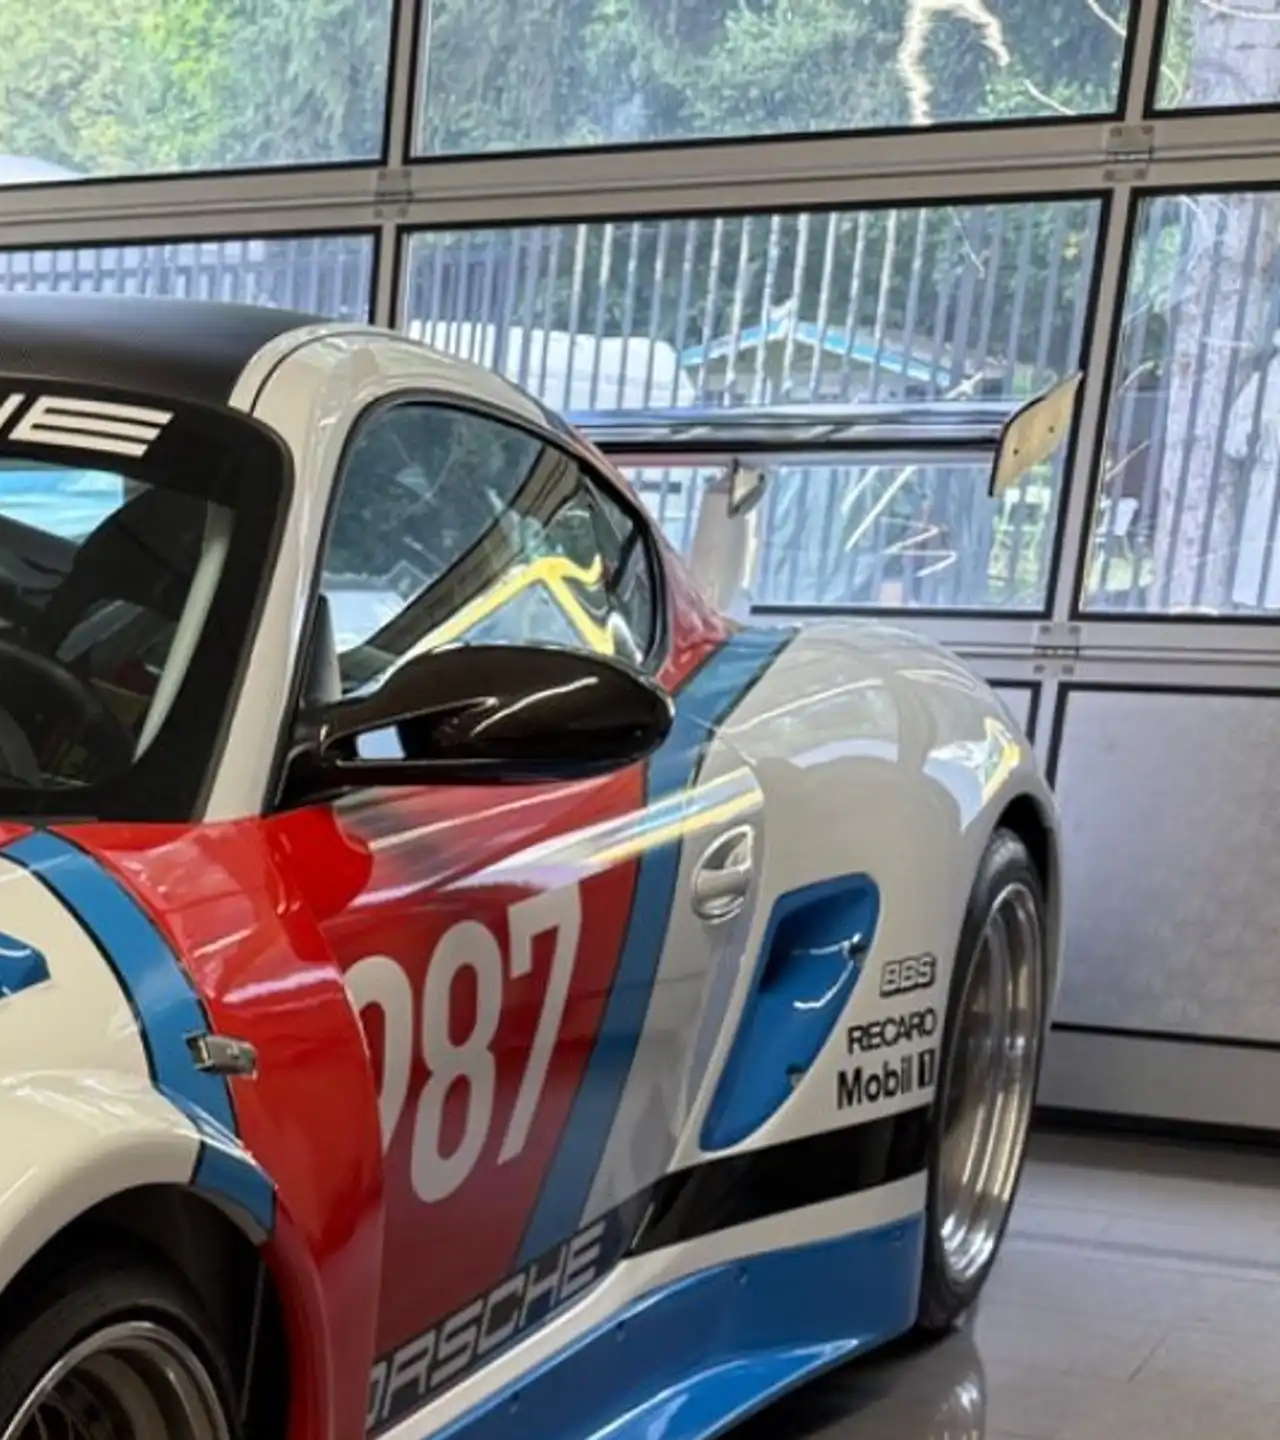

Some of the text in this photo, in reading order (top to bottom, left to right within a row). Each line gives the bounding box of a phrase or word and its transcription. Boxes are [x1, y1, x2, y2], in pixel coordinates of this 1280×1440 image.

[879, 951, 936, 999] BBS
[847, 1006, 938, 1056] RECARO
[837, 1055, 913, 1110] Mobil
[367, 1220, 606, 1428] RSCHE
